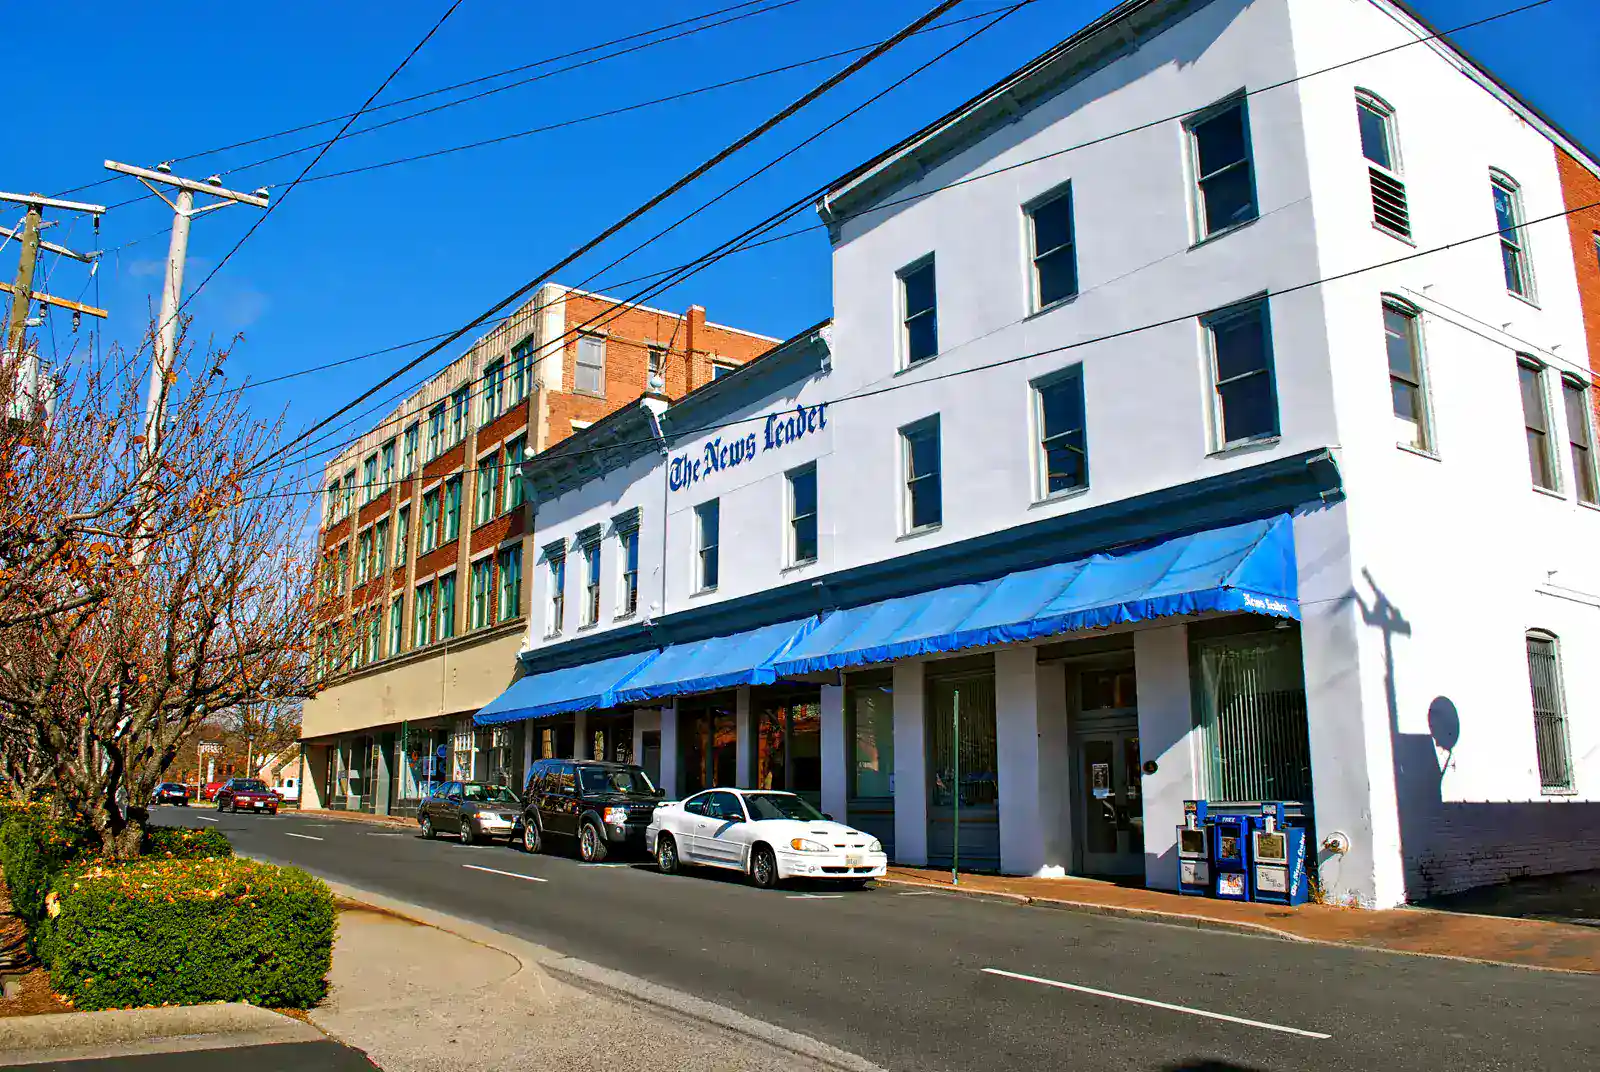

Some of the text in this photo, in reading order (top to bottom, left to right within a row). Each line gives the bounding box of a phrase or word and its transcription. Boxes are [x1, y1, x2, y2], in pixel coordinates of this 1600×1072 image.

[669, 403, 828, 492] The News Leader
